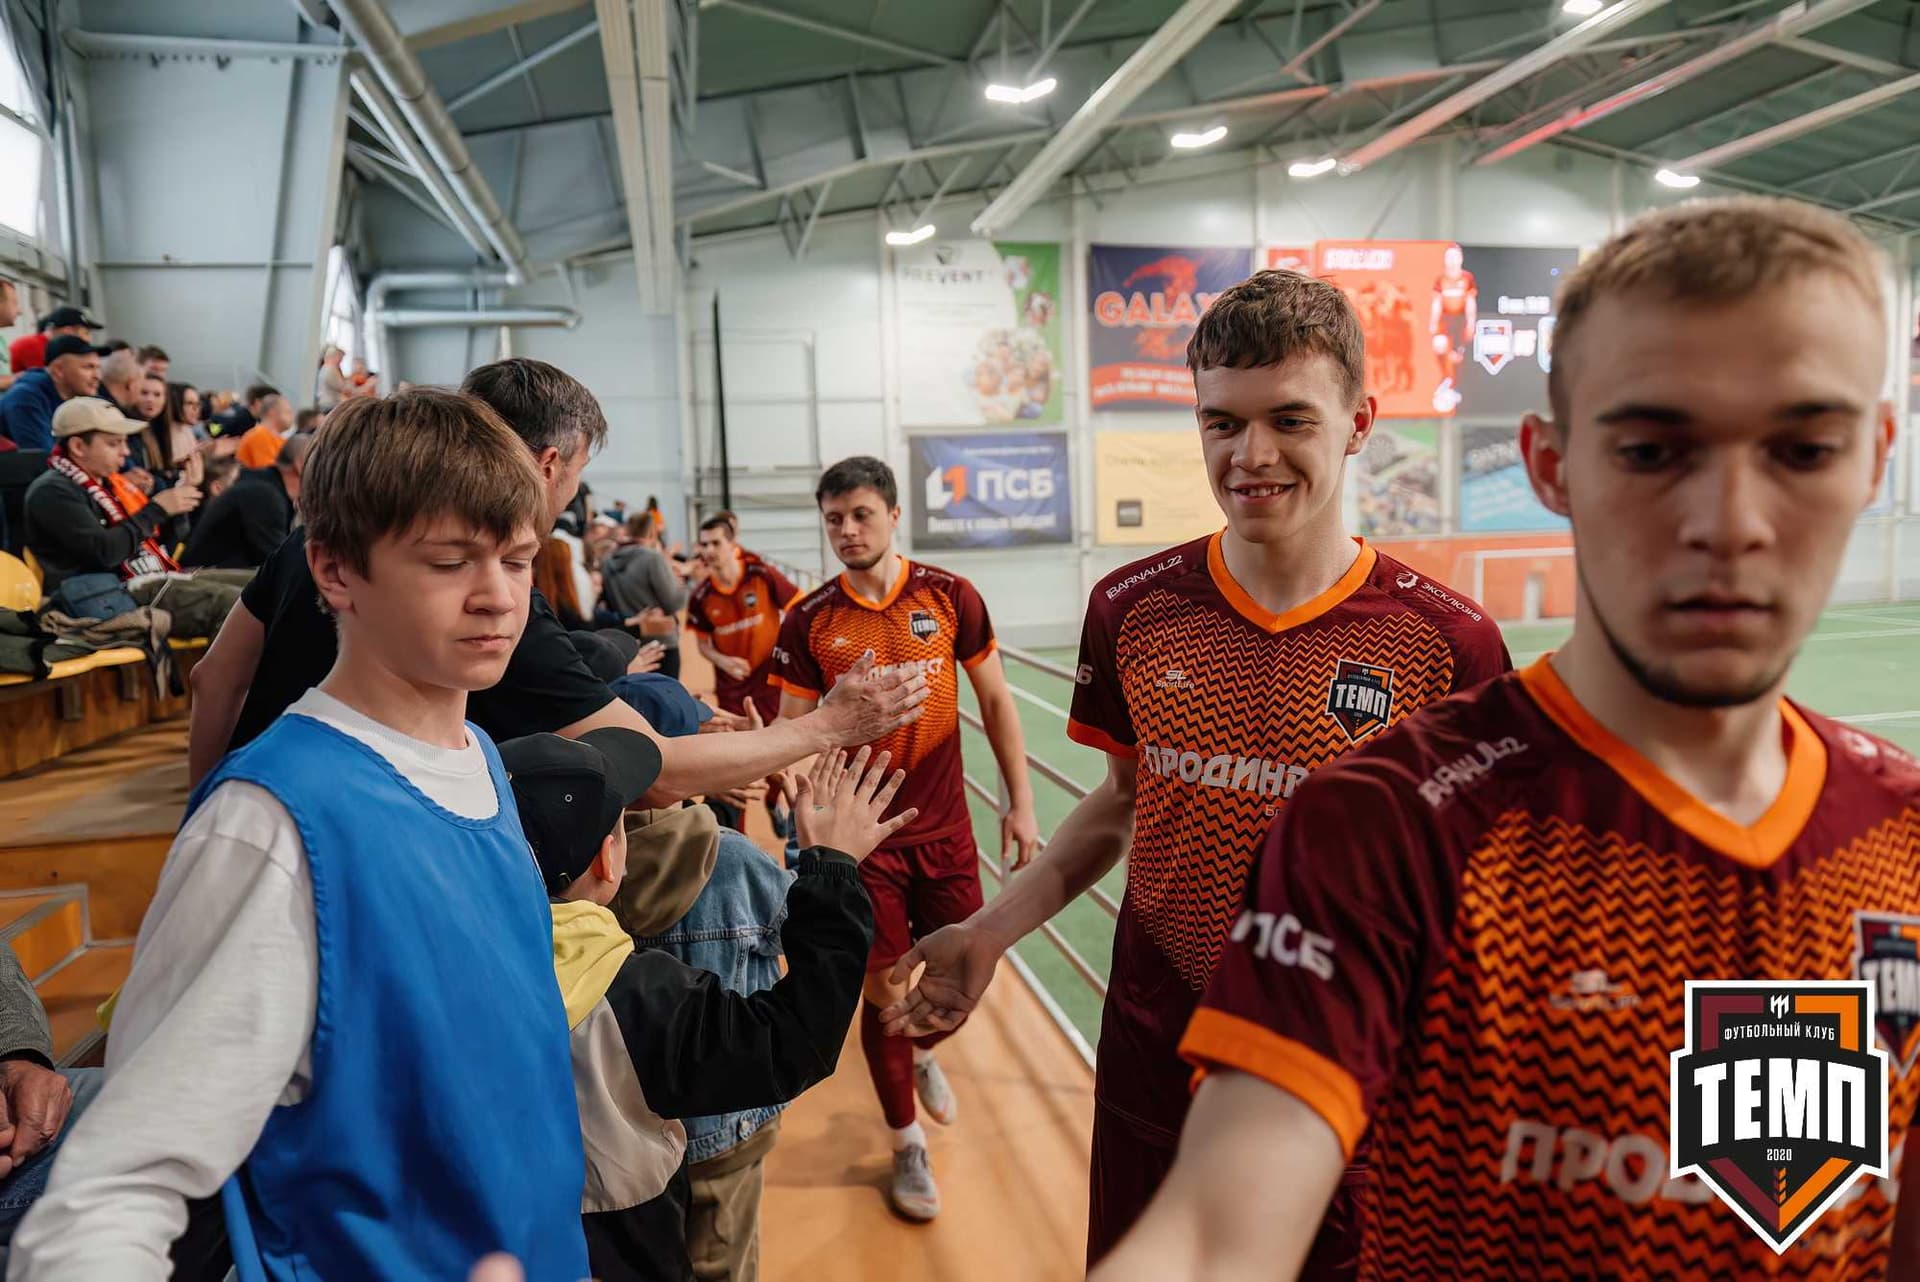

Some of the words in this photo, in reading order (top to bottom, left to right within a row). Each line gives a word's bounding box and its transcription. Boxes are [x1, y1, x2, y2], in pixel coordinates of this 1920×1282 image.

[977, 468, 1054, 502] ПСБ
[1105, 555, 1183, 599] BARNAUL22
[1421, 582, 1482, 622] ЭКСКЛЮЗИВ
[1155, 679, 1195, 689] SportLife
[1335, 684, 1388, 719] ТЕМП
[1229, 910, 1335, 981] ПСБ
